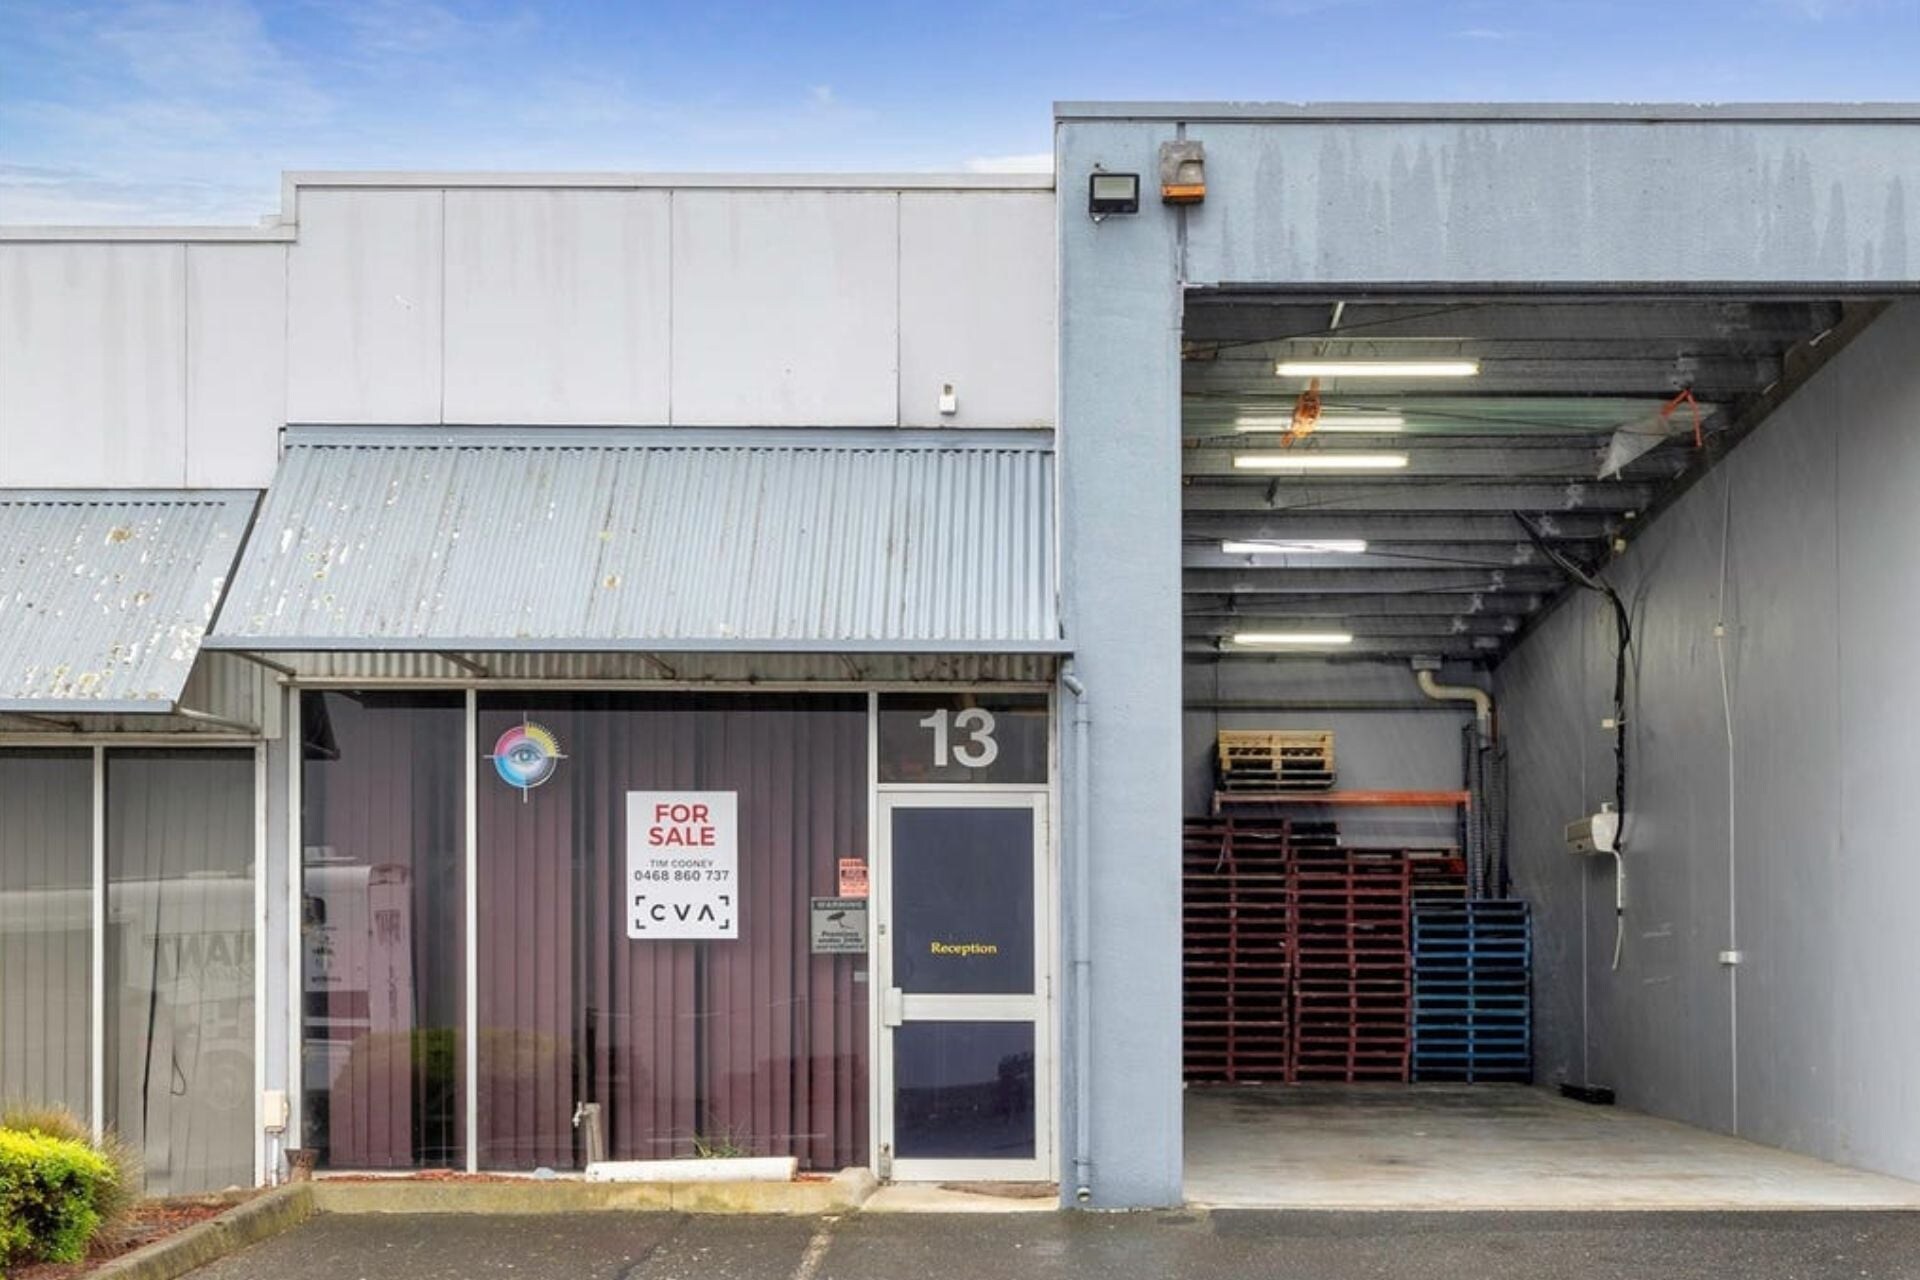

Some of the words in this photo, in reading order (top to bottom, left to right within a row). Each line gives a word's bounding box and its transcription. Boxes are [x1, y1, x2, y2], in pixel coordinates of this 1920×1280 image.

[919, 707, 998, 768] 13
[656, 804, 709, 823] FOR
[648, 826, 716, 846] SALE
[650, 859, 669, 868] TIM
[671, 859, 714, 868] COONEY
[634, 869, 670, 881] 0468
[674, 869, 701, 881] 860
[705, 869, 730, 881] 737
[650, 904, 716, 922] CVA
[930, 941, 998, 957] Reception
